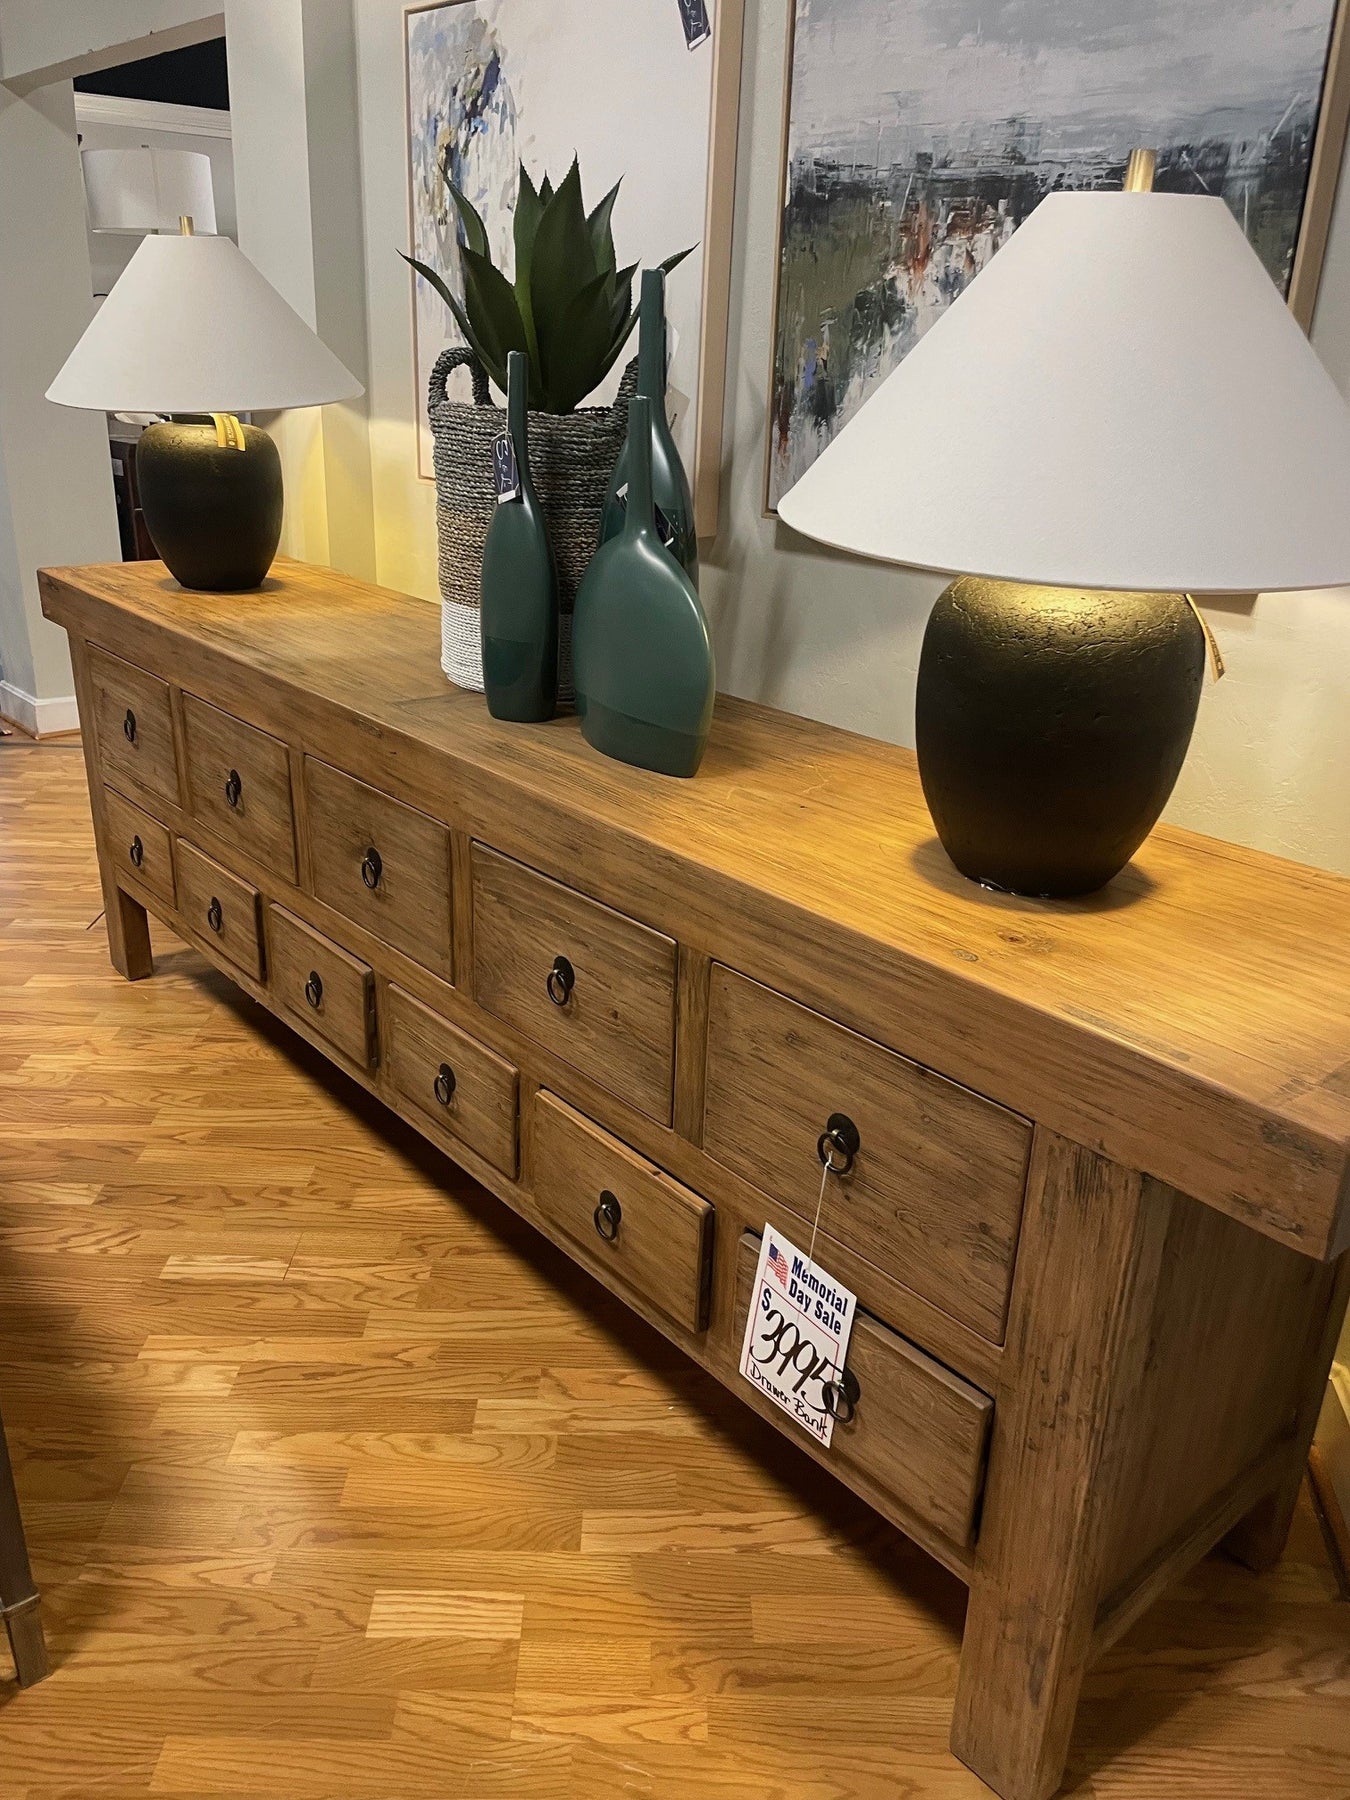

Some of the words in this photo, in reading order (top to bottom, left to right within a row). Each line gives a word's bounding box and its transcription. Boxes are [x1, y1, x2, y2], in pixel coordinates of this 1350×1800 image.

[788, 1279, 811, 1313] Day
[814, 1300, 842, 1335] Sale
[791, 1256, 848, 1317] Memorial
[750, 1361, 791, 1405] Drawer
[793, 1397, 828, 1438] Bank
